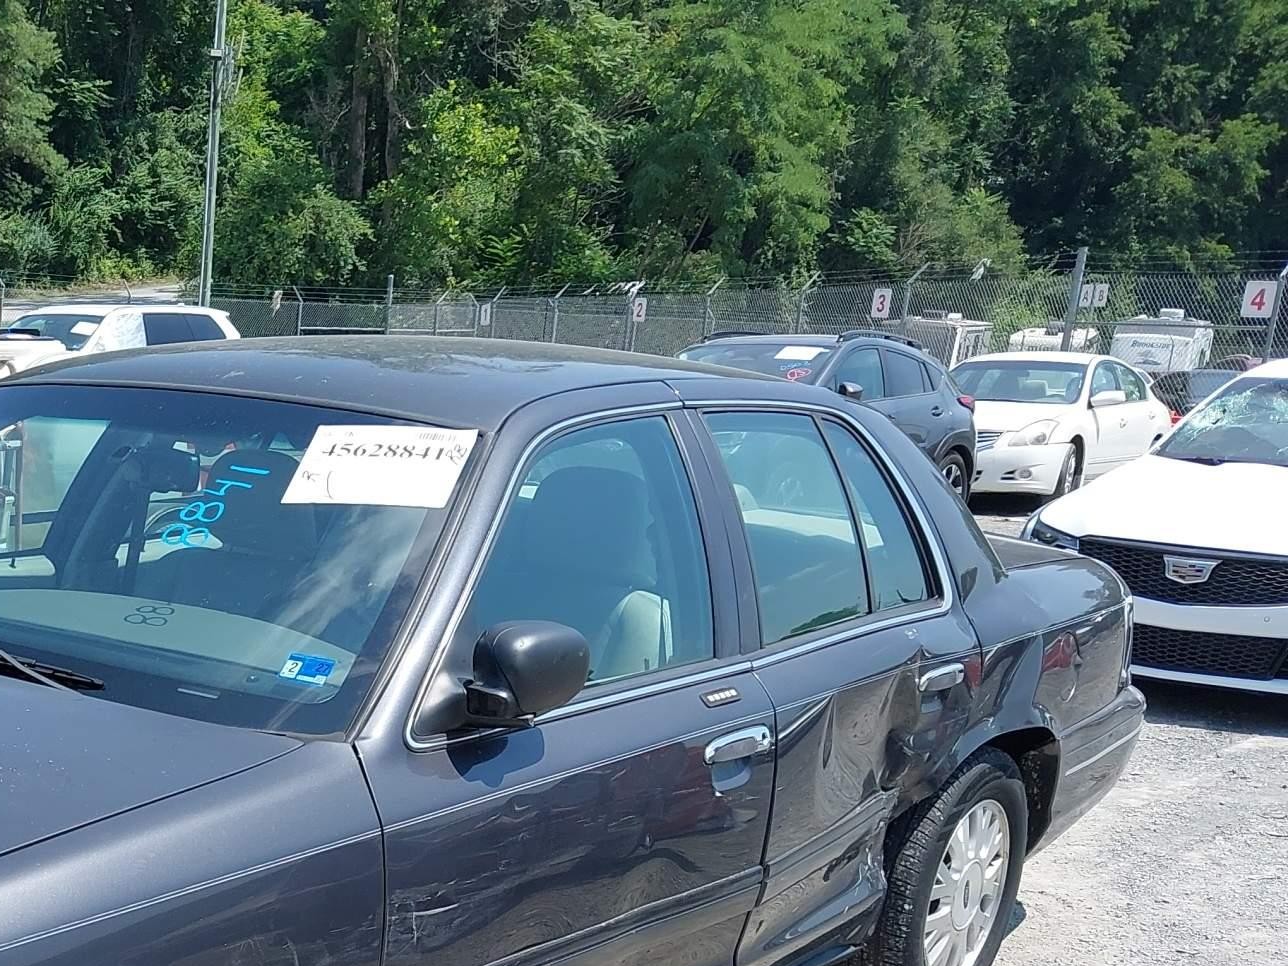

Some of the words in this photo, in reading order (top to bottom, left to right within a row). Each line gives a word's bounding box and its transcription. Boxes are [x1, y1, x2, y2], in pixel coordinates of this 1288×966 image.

[876, 294, 887, 312] 3
[1082, 290, 1089, 301] A
[1098, 290, 1105, 301] B
[1249, 288, 1266, 311] 4
[636, 302, 643, 318] 2
[321, 443, 445, 460] 45628841
[162, 465, 270, 547] 8841
[288, 662, 298, 673] 2
